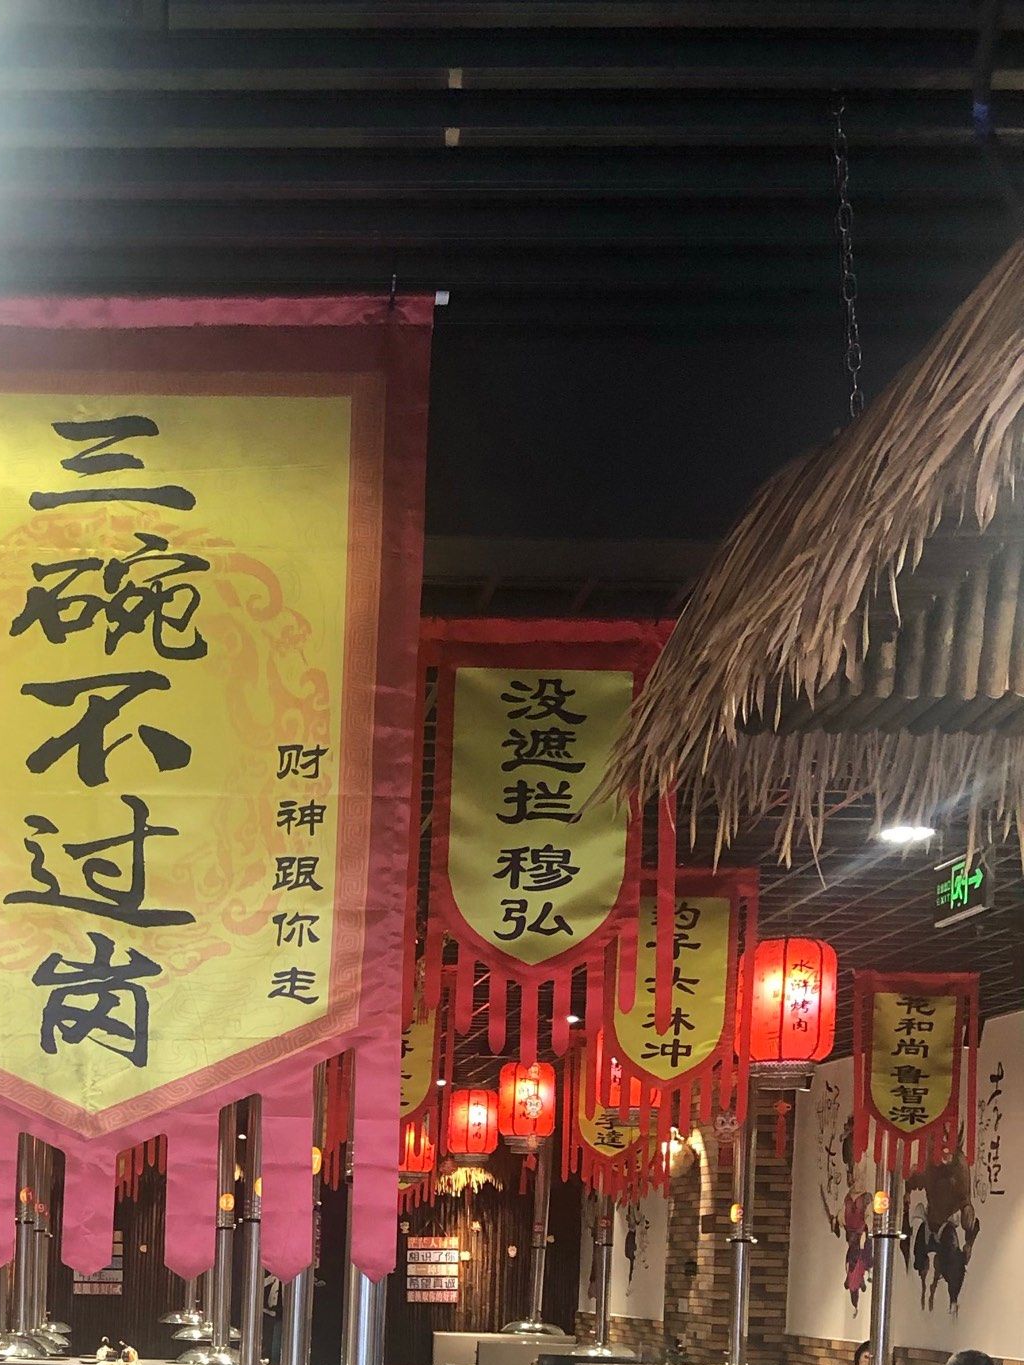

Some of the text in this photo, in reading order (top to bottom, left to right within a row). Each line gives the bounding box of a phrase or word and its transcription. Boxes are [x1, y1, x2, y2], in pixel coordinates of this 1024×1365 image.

[3, 414, 210, 1069] 三碗不过岗
[268, 743, 330, 1006] 财神跟你走
[790, 959, 814, 1033] 水浒烤肉
